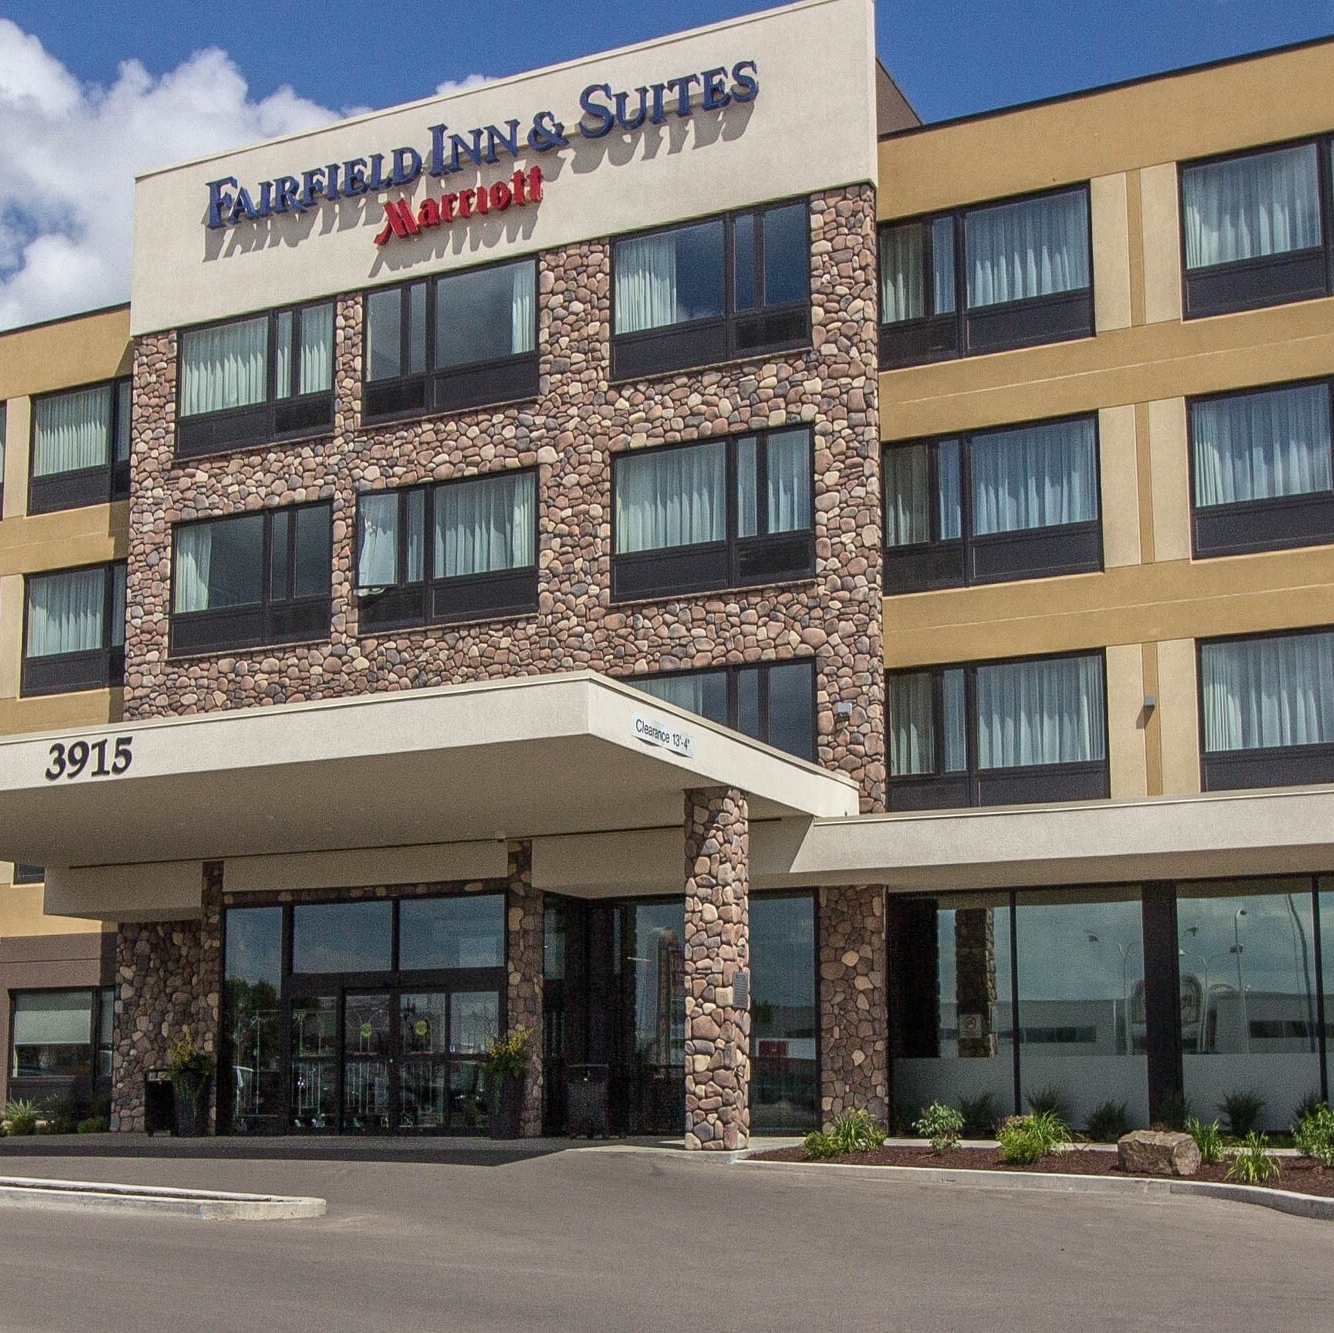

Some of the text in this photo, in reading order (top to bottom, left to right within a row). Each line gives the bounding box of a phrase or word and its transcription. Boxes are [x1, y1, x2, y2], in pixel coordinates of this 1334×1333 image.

[205, 61, 760, 230] FAIRFIELD INN & SUITES
[373, 165, 544, 246] Marriott
[45, 736, 133, 781] 3915
[635, 718, 670, 744] Clearance
